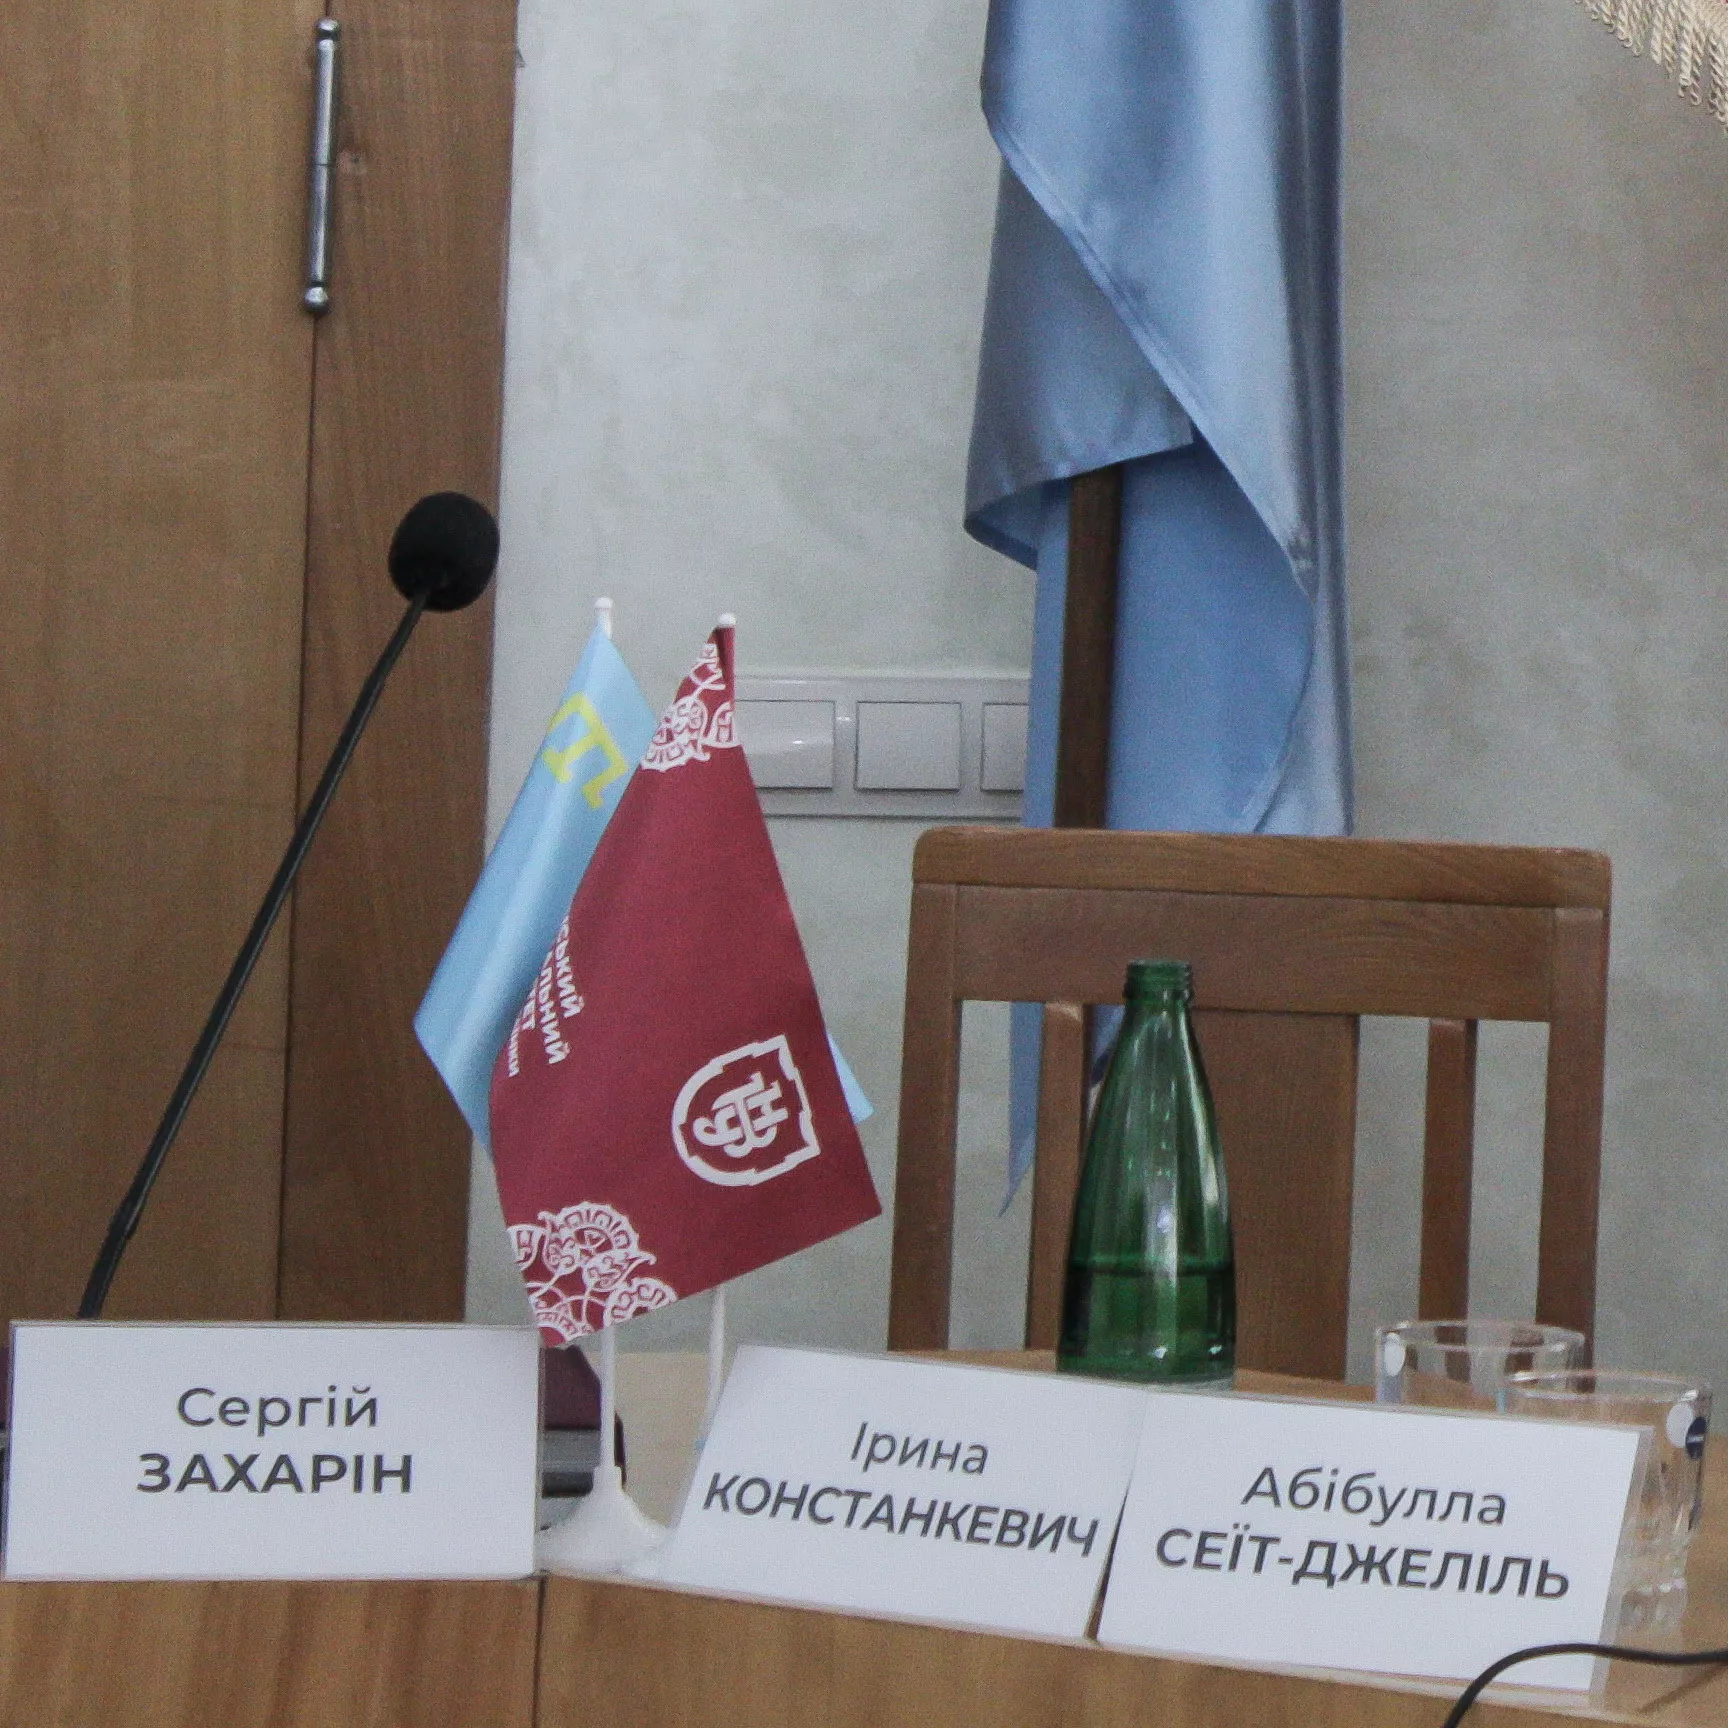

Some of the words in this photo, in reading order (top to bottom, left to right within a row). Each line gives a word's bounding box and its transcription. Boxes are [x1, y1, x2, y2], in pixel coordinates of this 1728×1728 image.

[176, 1384, 378, 1437] Сергій
[136, 1452, 413, 1494] ЗАХАРІН
[850, 1422, 990, 1476] Ірина
[702, 1472, 1100, 1559] КОНСТАНКЕВИЧ
[1240, 1465, 1508, 1527] Абібулла
[1155, 1523, 1570, 1601] СЕЇТ-ДЖЕЛІЛЬ
